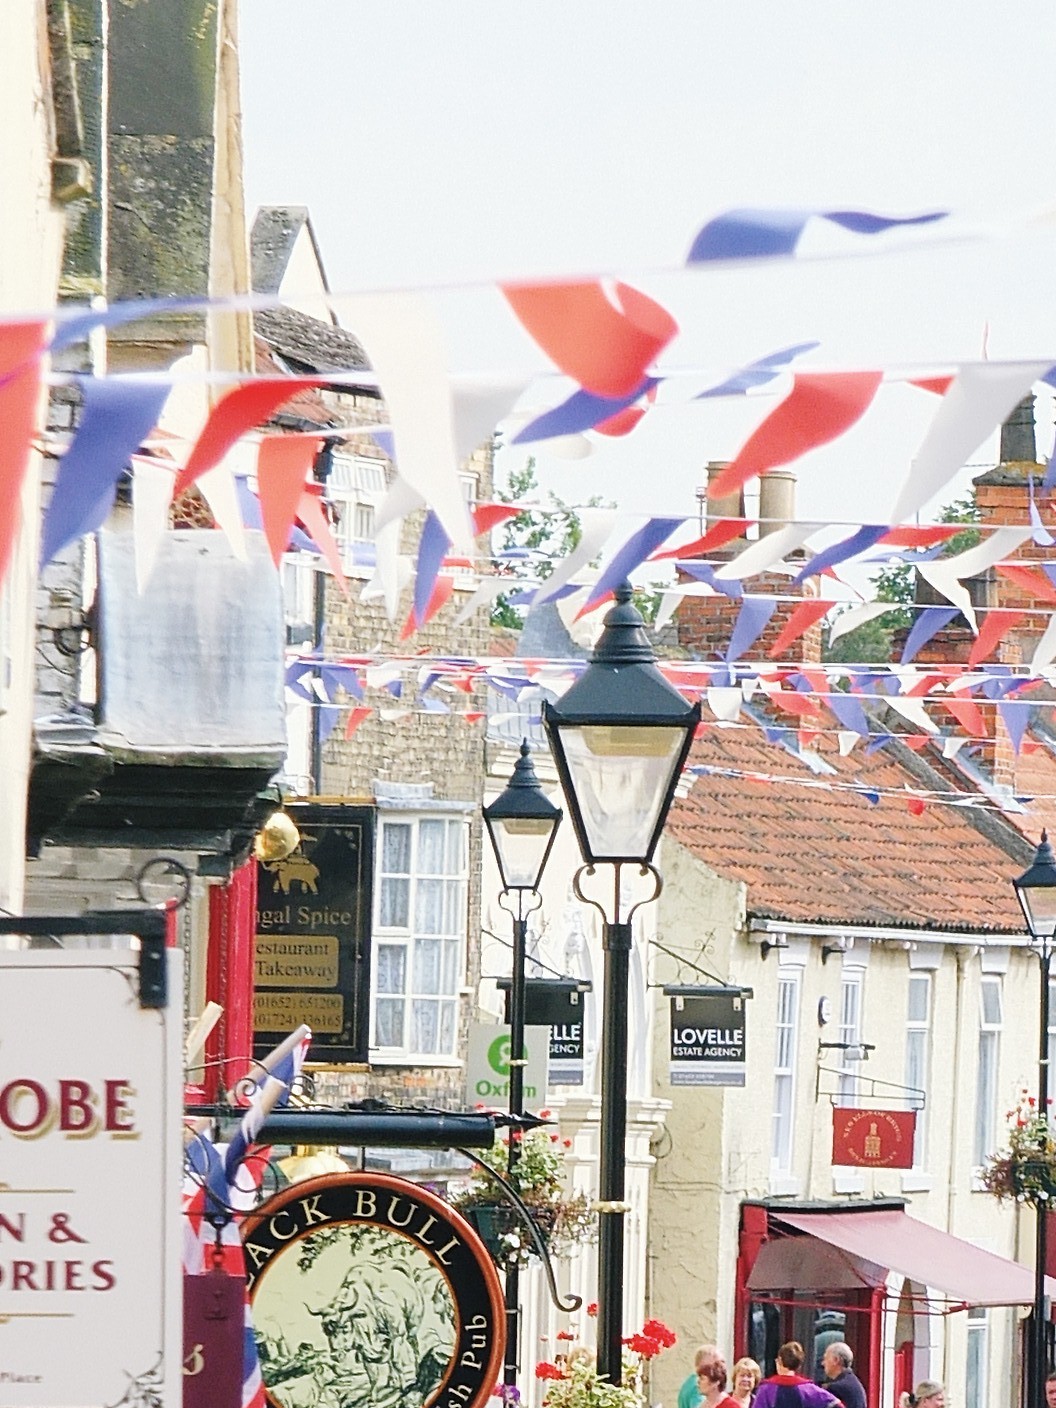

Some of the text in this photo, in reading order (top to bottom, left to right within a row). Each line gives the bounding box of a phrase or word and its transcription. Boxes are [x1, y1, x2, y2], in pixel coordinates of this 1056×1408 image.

[297, 905, 352, 930] Spice
[256, 942, 329, 956] estaurant
[255, 960, 336, 982] Takeaway
[673, 1028, 743, 1045] LOVELLE
[672, 1046, 742, 1057] ESTATE AGENCY
[475, 1079, 537, 1097] Oxfm
[0, 1079, 138, 1135] OBE
[47, 1212, 90, 1244] &
[352, 1189, 462, 1267] BULL
[0, 1259, 117, 1292] RIES
[460, 1313, 488, 1371] Pub
